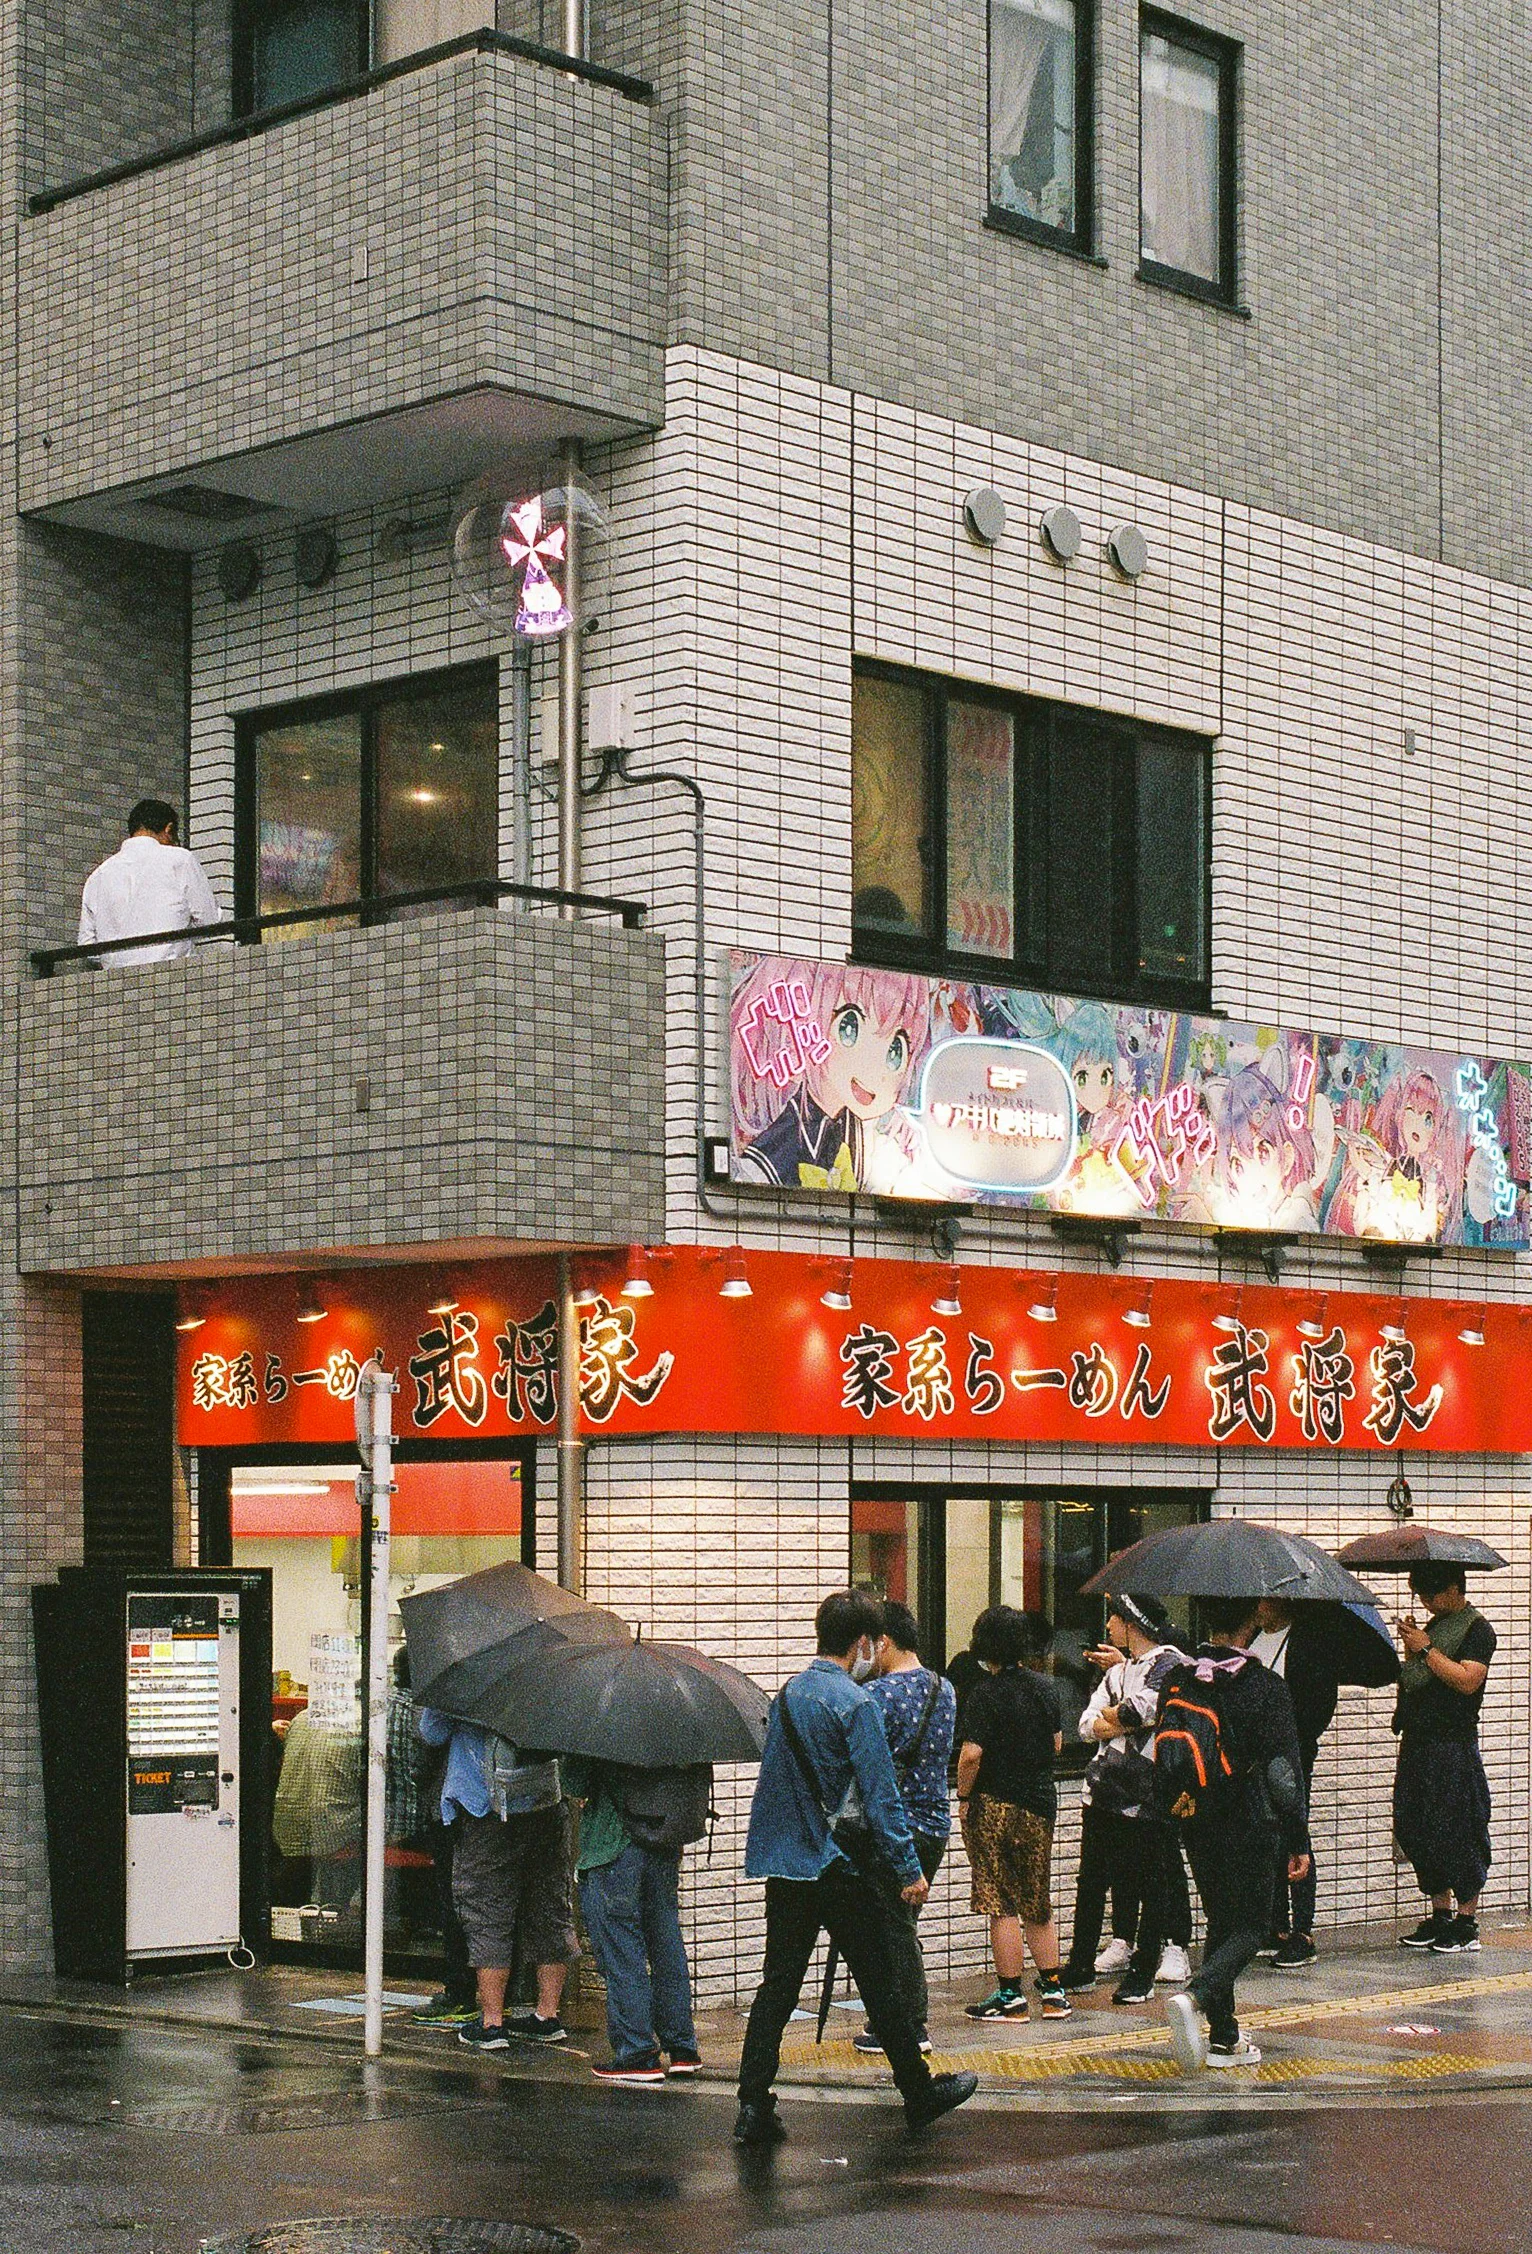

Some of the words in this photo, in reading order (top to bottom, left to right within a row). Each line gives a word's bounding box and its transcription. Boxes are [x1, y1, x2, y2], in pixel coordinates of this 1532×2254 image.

[987, 1066, 1028, 1092] 2F
[191, 1348, 398, 1412] 家系らーめ
[839, 1322, 1171, 1420] 家系らーめん
[1206, 1326, 1445, 1445] 武将家
[134, 1771, 171, 1785] TICKET
